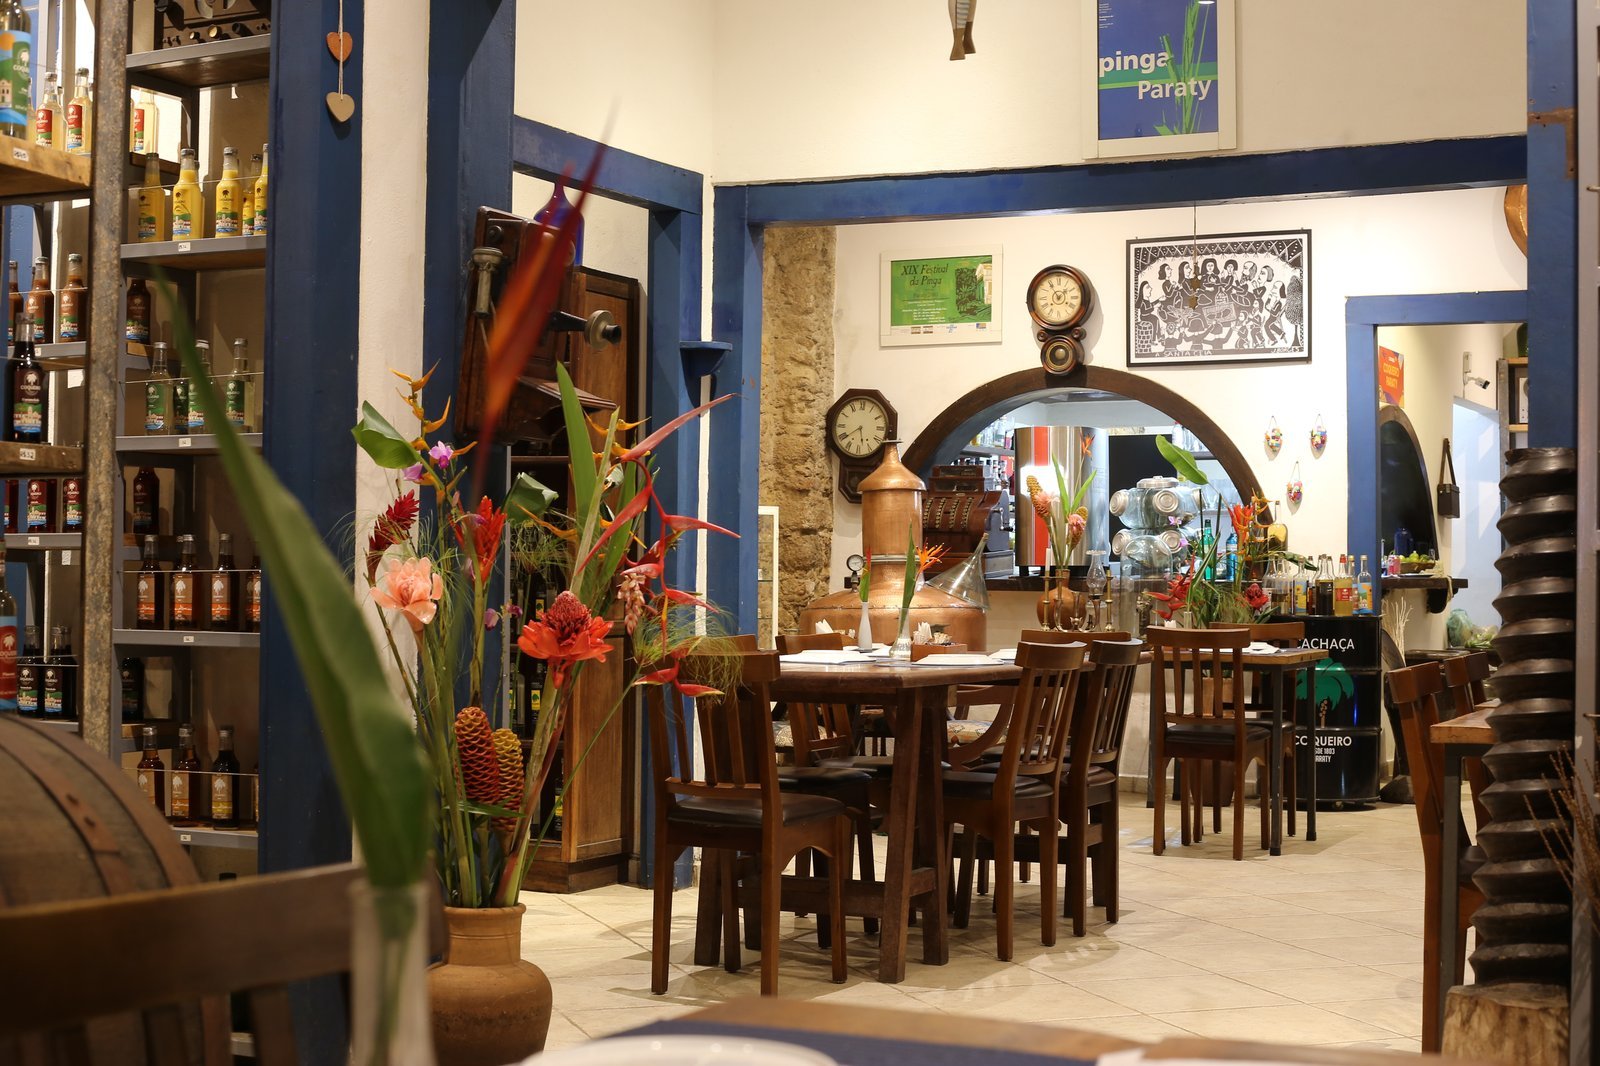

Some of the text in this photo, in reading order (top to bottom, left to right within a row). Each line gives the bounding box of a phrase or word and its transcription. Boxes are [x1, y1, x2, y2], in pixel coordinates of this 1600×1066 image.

[1099, 50, 1169, 77] pinga
[1138, 77, 1212, 100] Paraty
[901, 263, 949, 276] XIX Festival
[1298, 638, 1355, 652] ACHAÇA
[1315, 755, 1332, 763] ARATY
